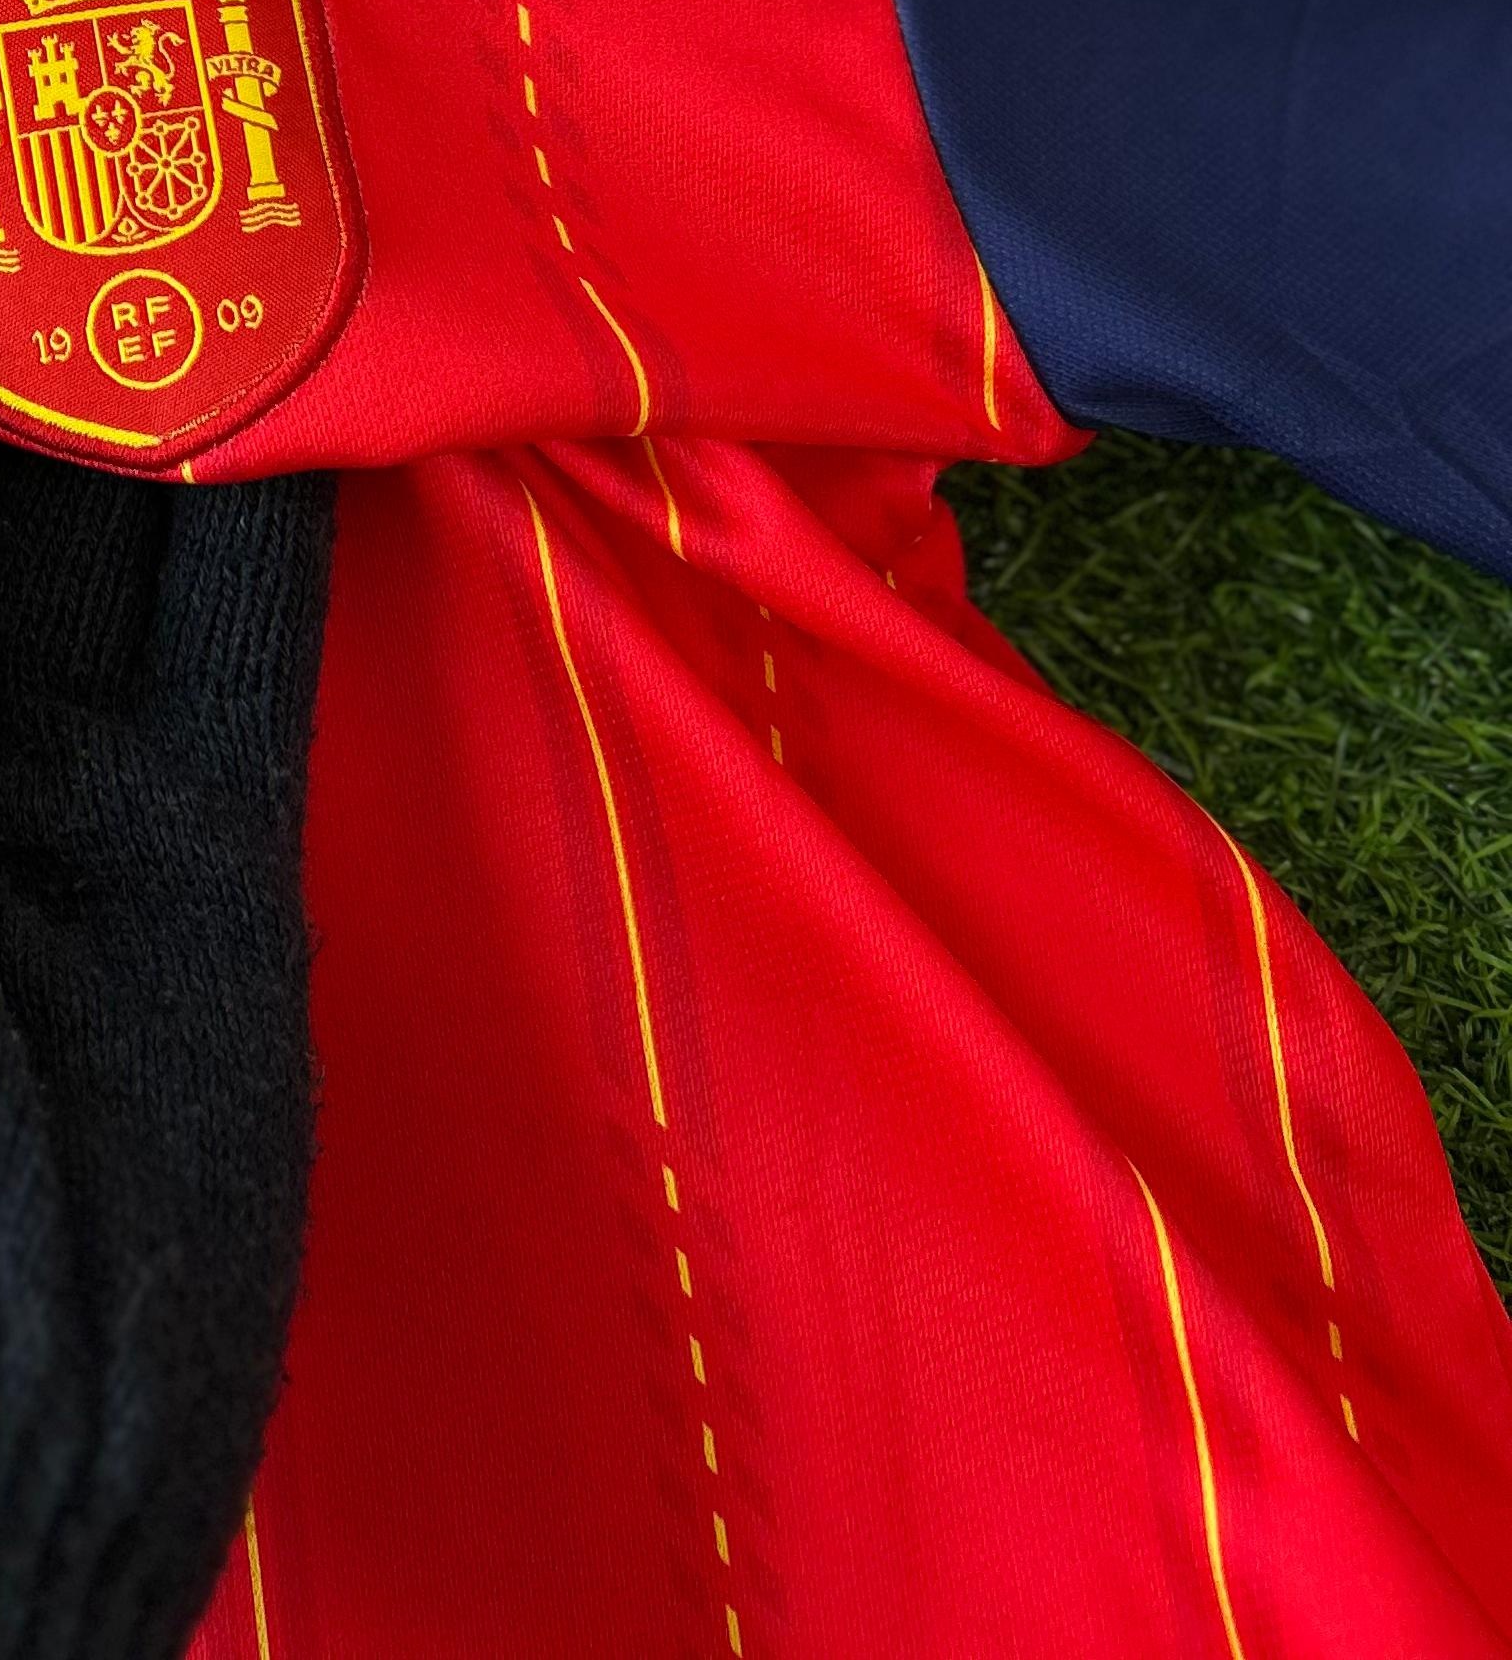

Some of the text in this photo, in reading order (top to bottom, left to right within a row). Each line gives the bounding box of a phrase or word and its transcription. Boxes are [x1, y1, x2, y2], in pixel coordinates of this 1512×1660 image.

[208, 55, 275, 78] VLTRA
[216, 293, 264, 333] 09
[31, 326, 72, 365] 19
